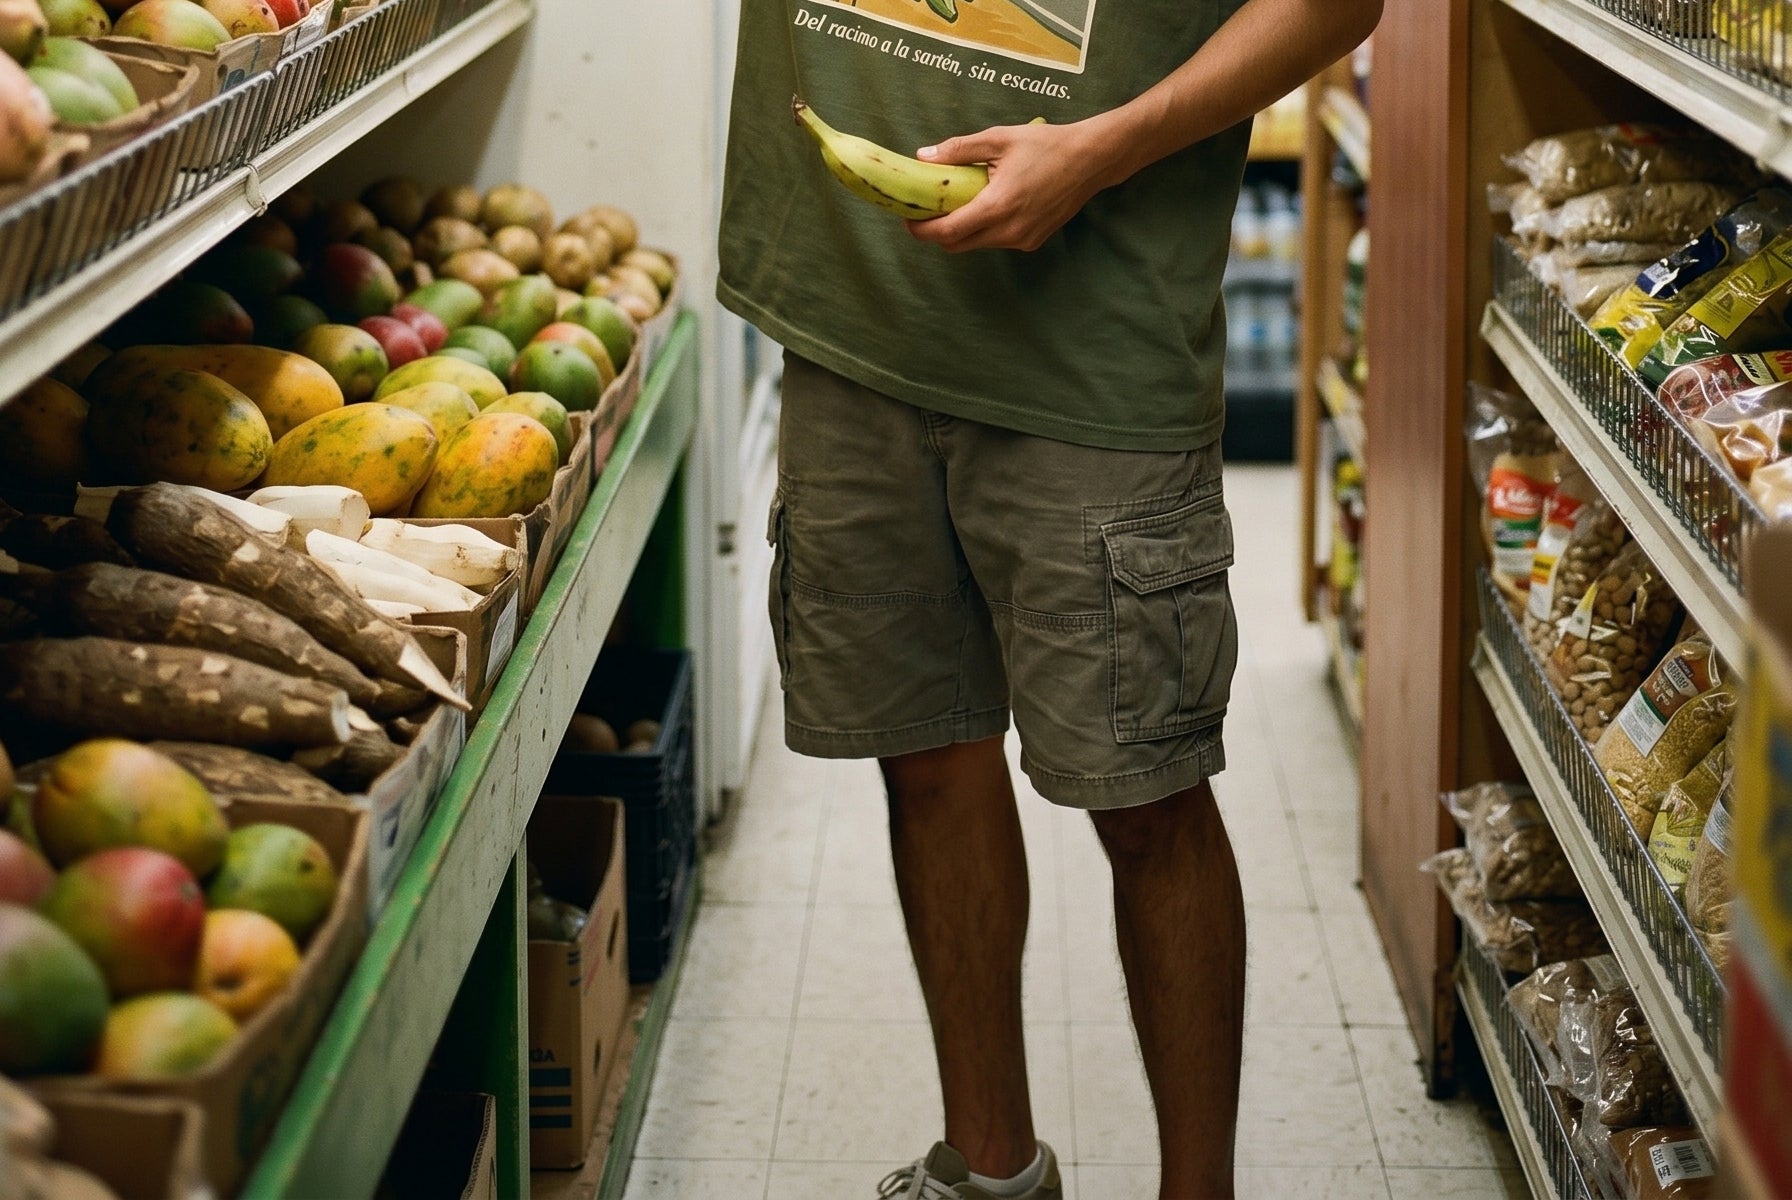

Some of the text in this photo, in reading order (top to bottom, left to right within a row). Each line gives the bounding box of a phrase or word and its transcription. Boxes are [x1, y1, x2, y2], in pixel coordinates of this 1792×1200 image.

[793, 8, 1072, 101] Del racimo a la sartén, sin escalas.
